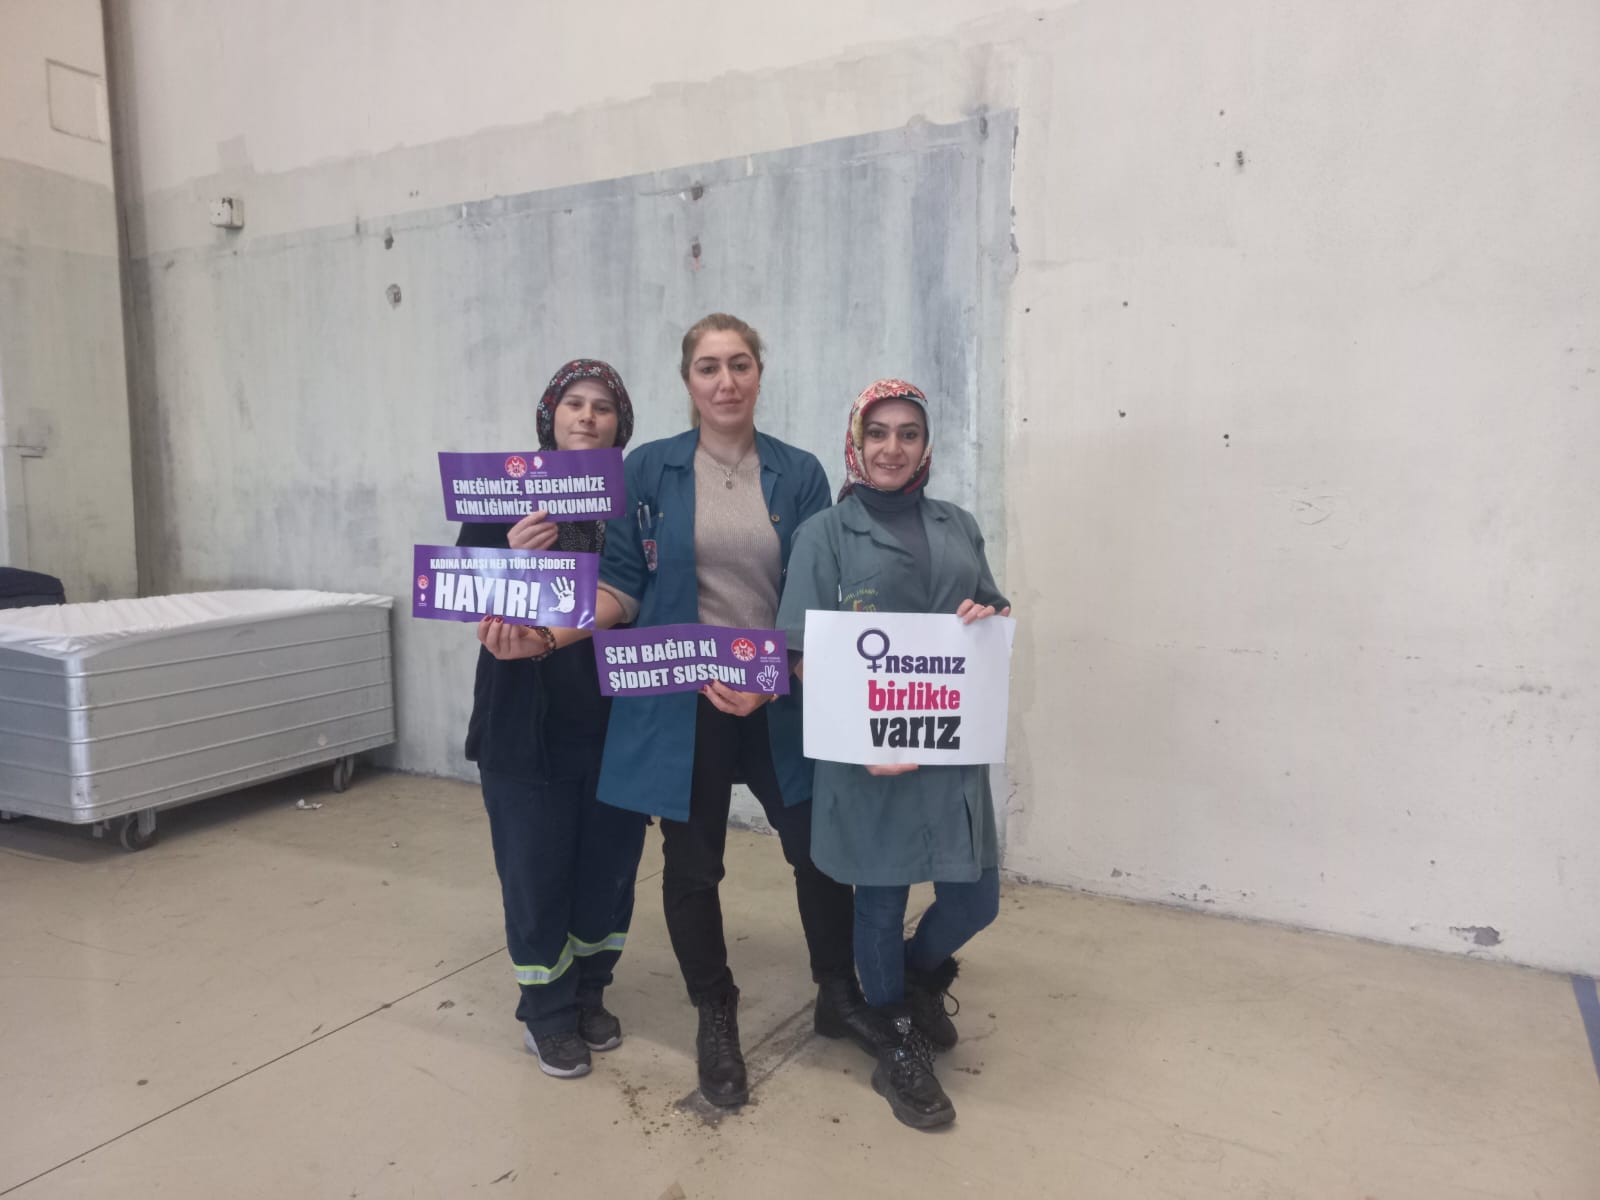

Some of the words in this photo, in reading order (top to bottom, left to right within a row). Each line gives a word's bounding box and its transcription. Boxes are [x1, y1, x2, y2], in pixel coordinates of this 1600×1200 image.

[452, 476, 523, 496] EMEĞİMİZE,
[525, 475, 605, 494] BEDENİMİZE
[455, 497, 533, 515] KİMLİĞİMİZE
[538, 497, 612, 515] DOKUNMA!
[430, 558, 460, 570] KADINA
[461, 558, 488, 571] KARŞI
[490, 558, 508, 570] HER
[509, 556, 537, 570] TÜRLÜ
[538, 556, 576, 572] ŞİDDETE
[434, 571, 541, 620] HAYIR!
[604, 645, 640, 665] SEN
[641, 639, 696, 663] BAĞIR
[699, 638, 718, 658] Kİ
[608, 668, 670, 692] ŞİDDET
[673, 663, 746, 686] SUSSUN!
[868, 679, 961, 712] birlikte
[869, 715, 961, 750] varız
